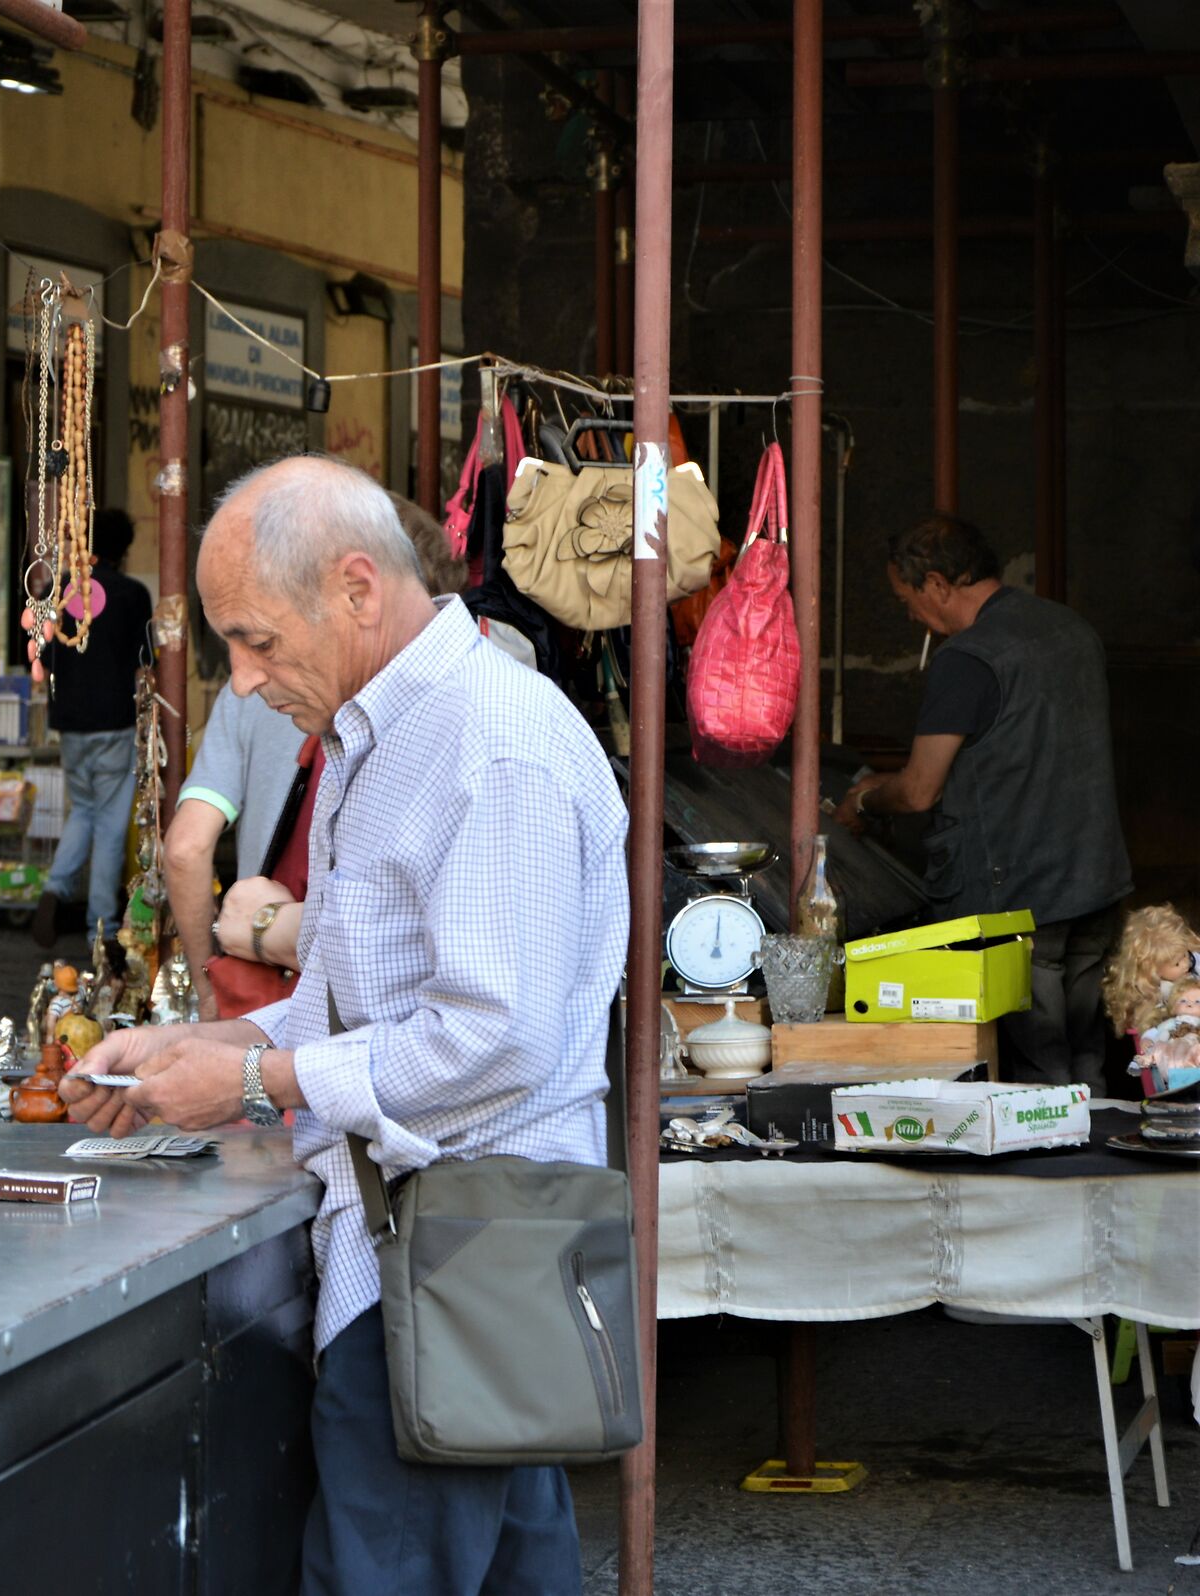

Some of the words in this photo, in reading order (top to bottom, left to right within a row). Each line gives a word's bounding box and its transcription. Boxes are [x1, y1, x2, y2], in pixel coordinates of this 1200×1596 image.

[851, 941, 887, 956] adidas
[887, 938, 908, 951] neo
[965, 1109, 981, 1127] SIN
[1016, 1105, 1069, 1124] BONELLE
[946, 1122, 968, 1147] GLUTEN
[11, 1185, 59, 1195] NAPOLETANE
